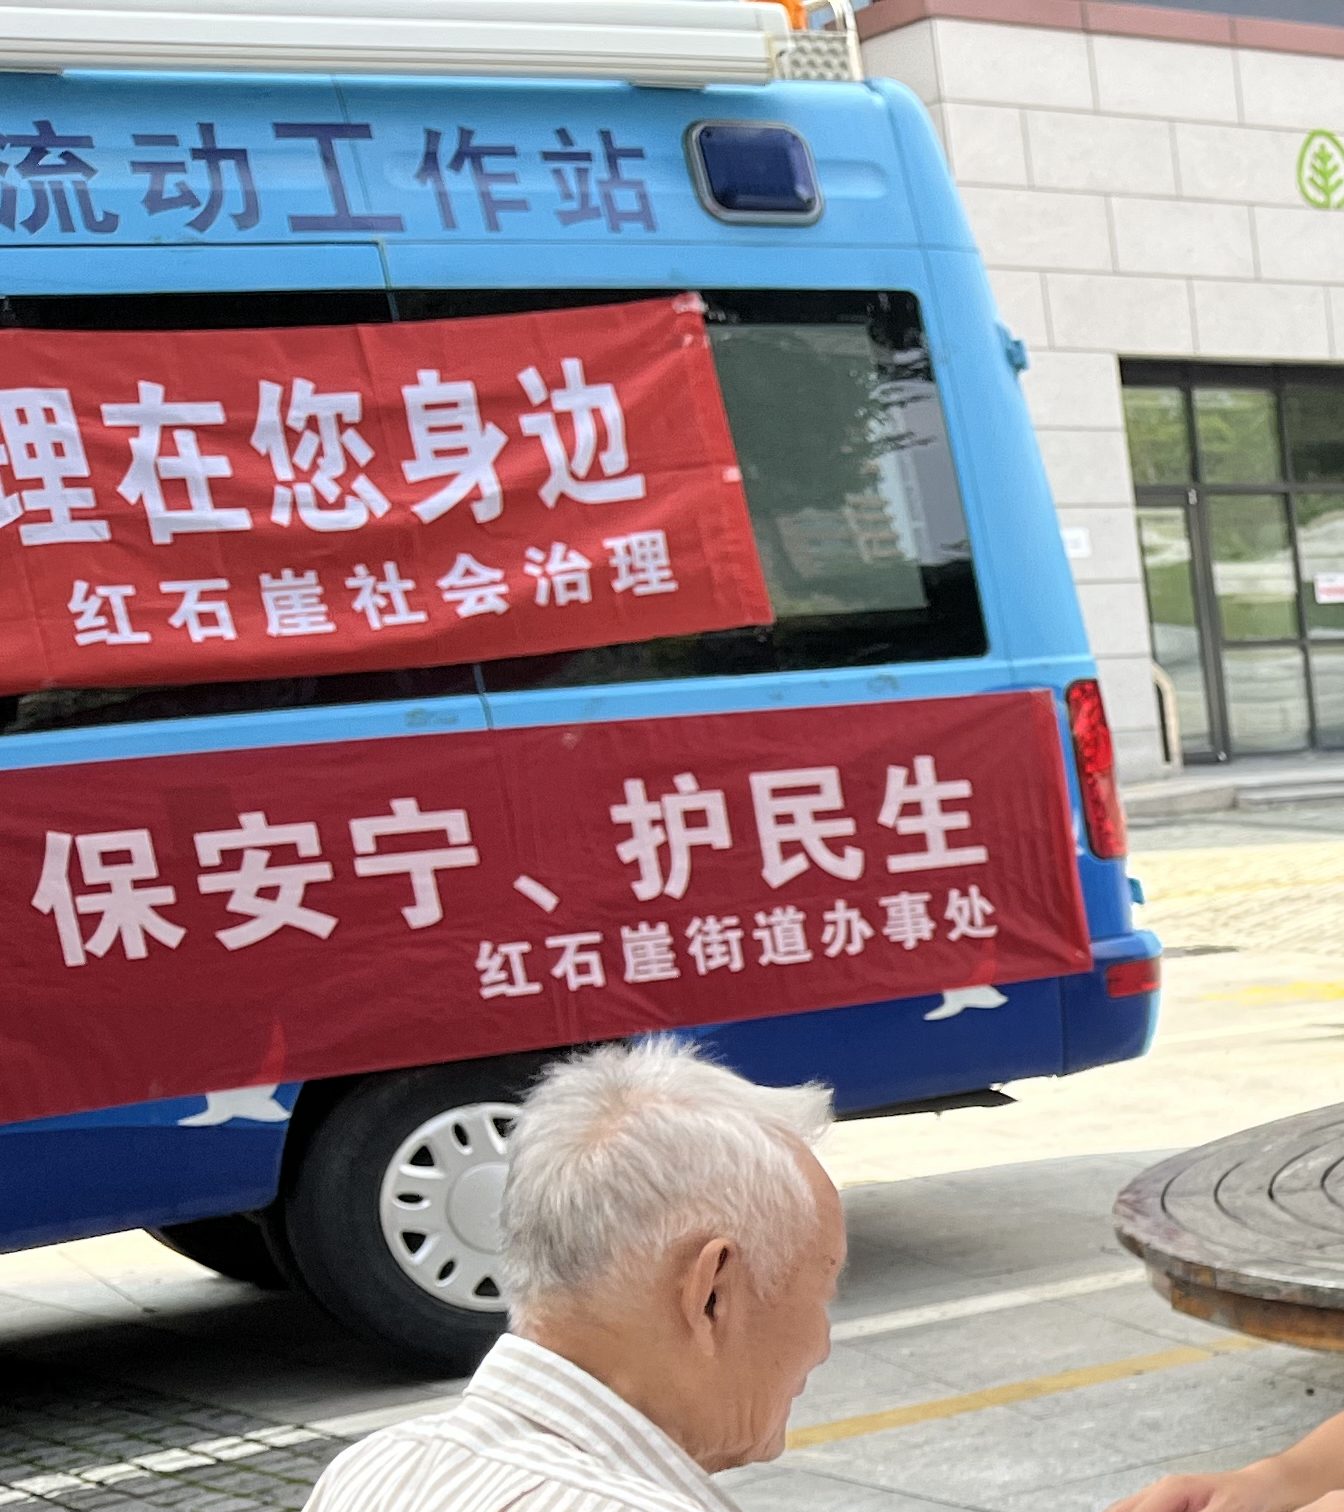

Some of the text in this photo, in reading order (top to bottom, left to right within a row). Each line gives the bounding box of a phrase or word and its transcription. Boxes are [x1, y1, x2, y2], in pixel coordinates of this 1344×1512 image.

[0, 119, 659, 235] 流动工作站
[0, 356, 648, 547] 理在您身边
[68, 529, 679, 647] 红石崖社会治理
[31, 753, 990, 968] 保安宁、护民生
[475, 885, 998, 1000] 红石崖街道办事处
